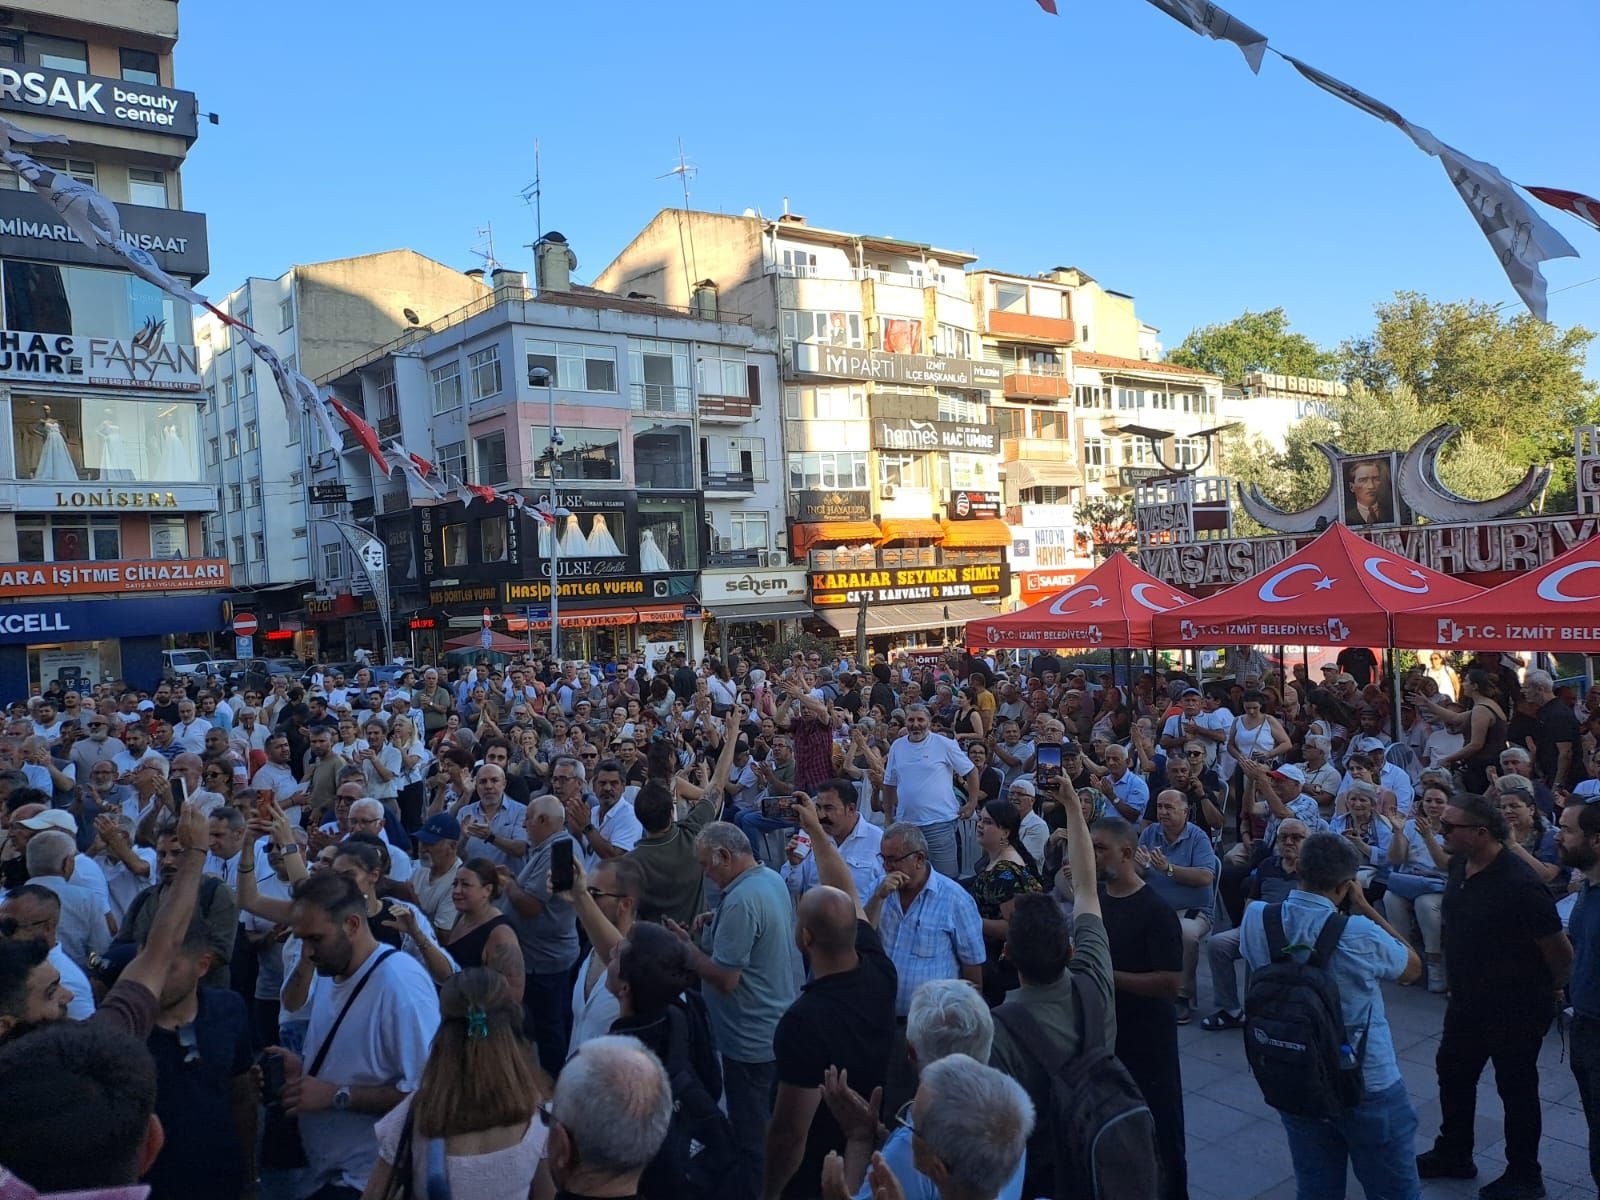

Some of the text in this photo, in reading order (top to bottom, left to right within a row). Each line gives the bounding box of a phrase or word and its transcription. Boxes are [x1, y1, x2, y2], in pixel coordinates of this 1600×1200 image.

[113, 87, 178, 113] beauty
[115, 105, 175, 126] center
[0, 217, 98, 246] MİMARL
[120, 229, 188, 254] İNŞAAT
[0, 331, 74, 355] HAC
[90, 338, 200, 381] FARAN
[826, 348, 895, 379] İYİ PARTİ
[925, 358, 946, 371] İZMİT
[905, 367, 923, 382] İLÇE
[923, 371, 968, 384] BAŞKANLIĞI
[942, 431, 994, 448] HAC UMRE
[56, 488, 178, 508] LONİSERA
[1035, 529, 1065, 545] NATO'YA
[1360, 518, 1596, 575] MHURİY
[1036, 545, 1066, 566] HAYIR!
[53, 566, 120, 587] İŞİTME
[124, 564, 225, 582] CİHAZLARI
[812, 564, 1001, 590] KARALAR SEYMEN SİMİT
[1039, 574, 1077, 588] SAADET
[511, 584, 538, 598] HAS
[603, 580, 644, 595] YUFKA
[879, 587, 930, 601] KAHVALTI
[932, 586, 939, 597] &
[942, 585, 971, 597] PASTA
[1000, 630, 1018, 640] T.C.
[1198, 625, 1224, 635] T.C.
[1260, 622, 1328, 636] BELEDİYESİ
[1465, 625, 1501, 639] T.C.
[1506, 624, 1555, 640] İZMİT
